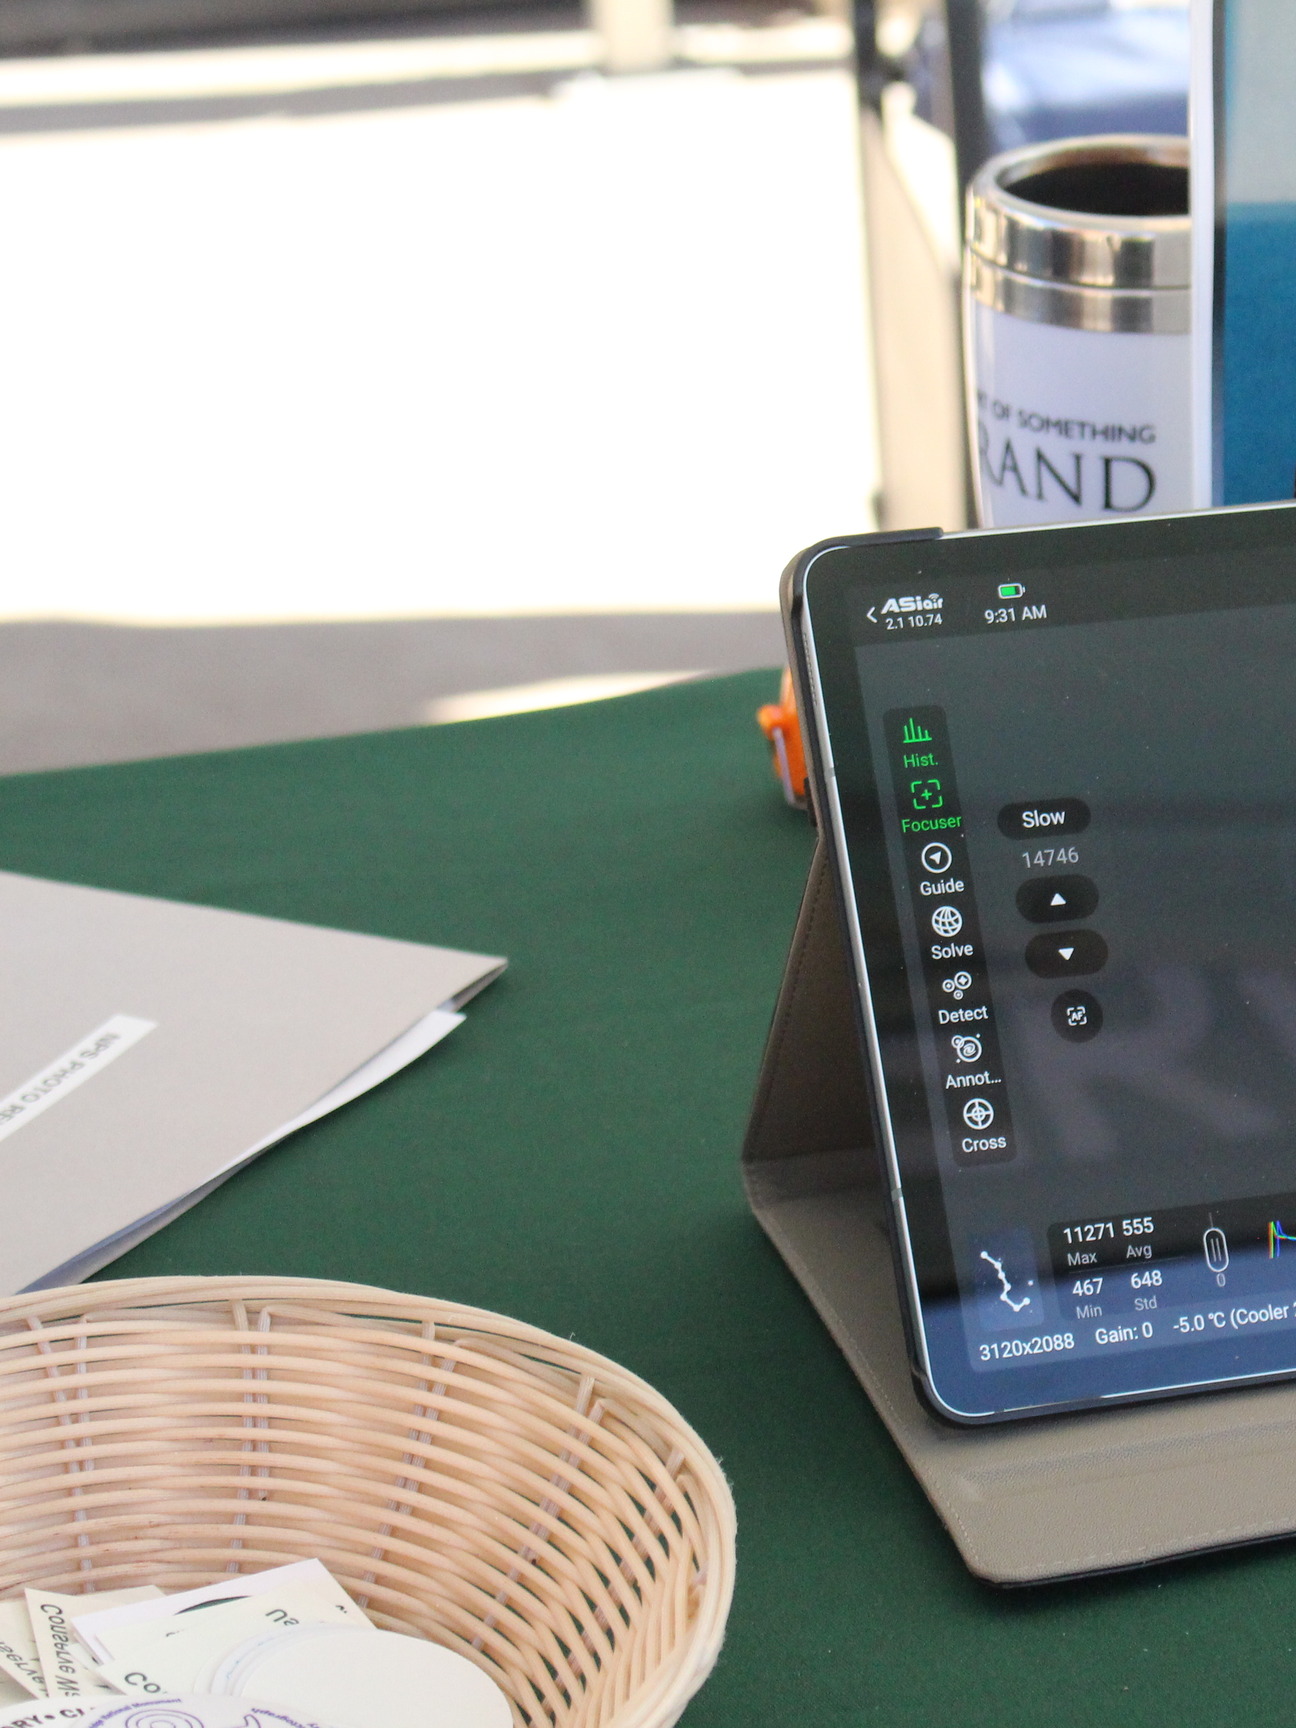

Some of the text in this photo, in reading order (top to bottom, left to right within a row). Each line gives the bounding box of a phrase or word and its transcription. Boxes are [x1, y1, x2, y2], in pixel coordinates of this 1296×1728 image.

[1017, 408, 1157, 445] SOMETHING
[977, 419, 1158, 513] RAND
[984, 605, 1048, 625] 9:31 AM
[903, 753, 940, 769] Hist.
[901, 815, 963, 834] Focuser
[1021, 809, 1067, 829] Slow
[1021, 846, 1080, 869] 14746
[919, 877, 966, 897] Guide
[930, 942, 975, 961] Solve
[937, 1005, 990, 1026] Detect
[20, 1060, 85, 1104] PHOTO
[960, 1135, 1008, 1153] Cross
[1062, 1216, 1155, 1245] 11271 555
[1066, 1244, 1153, 1267] Max Avg
[1071, 1269, 1164, 1298] 467 648
[1075, 1294, 1158, 1320] Min Std
[978, 1332, 1076, 1362] 3120x2088
[1094, 1324, 1139, 1345] Gain:
[1140, 1321, 1154, 1340] 0
[1172, 1313, 1206, 1334] -5.0
[1229, 1303, 1290, 1330] (Cooler
